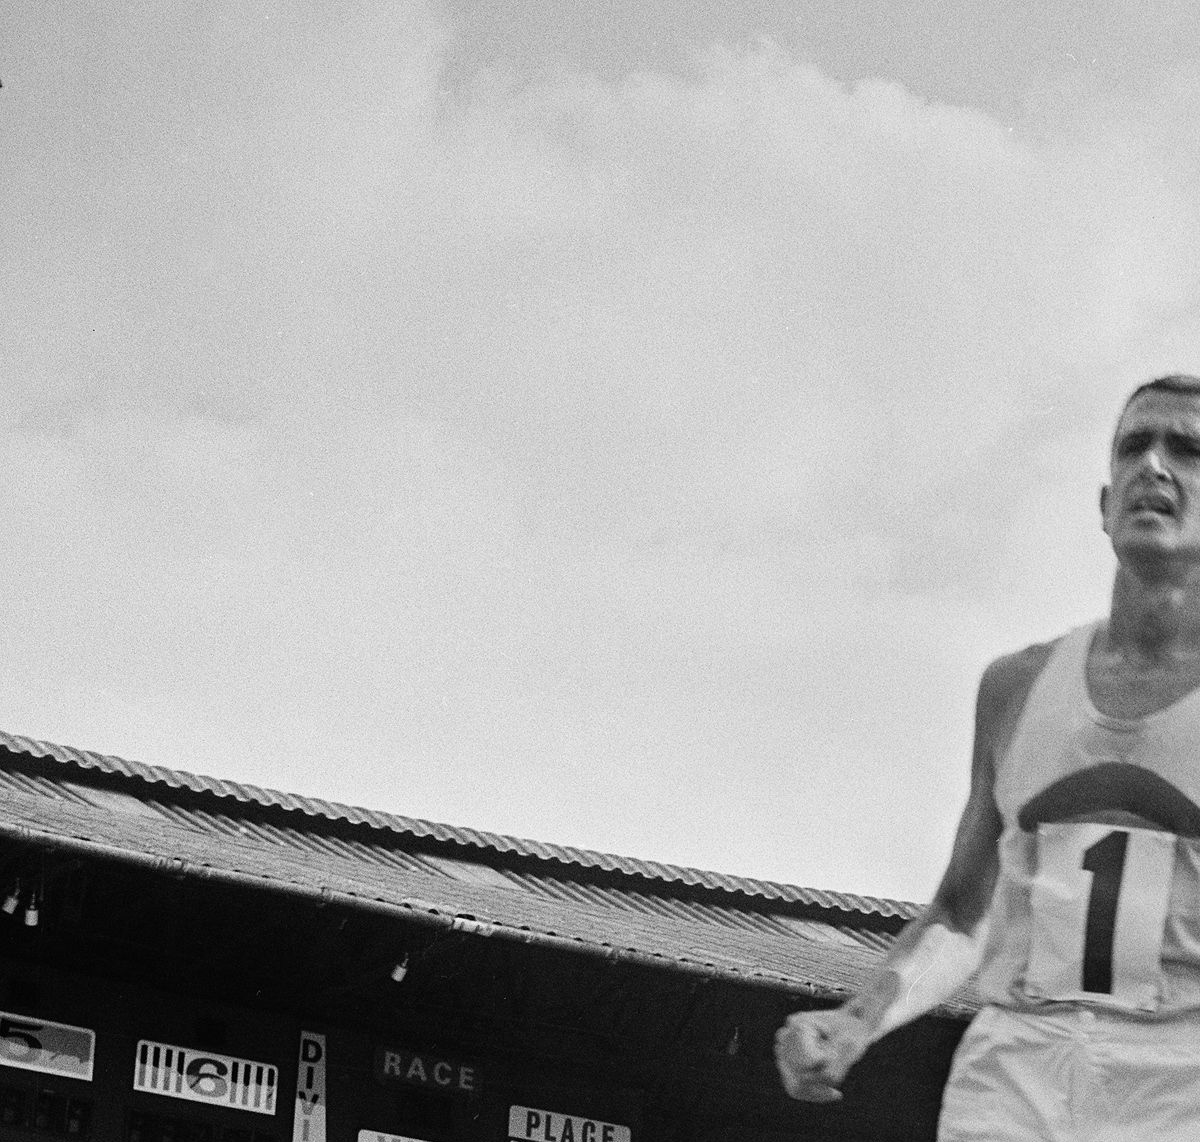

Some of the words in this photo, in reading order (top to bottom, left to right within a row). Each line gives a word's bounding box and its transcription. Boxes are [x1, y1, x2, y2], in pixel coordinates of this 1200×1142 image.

[1081, 830, 1129, 995] 1
[0, 1016, 43, 1064] 5
[186, 1056, 228, 1099] 6
[383, 1050, 475, 1091] RACE
